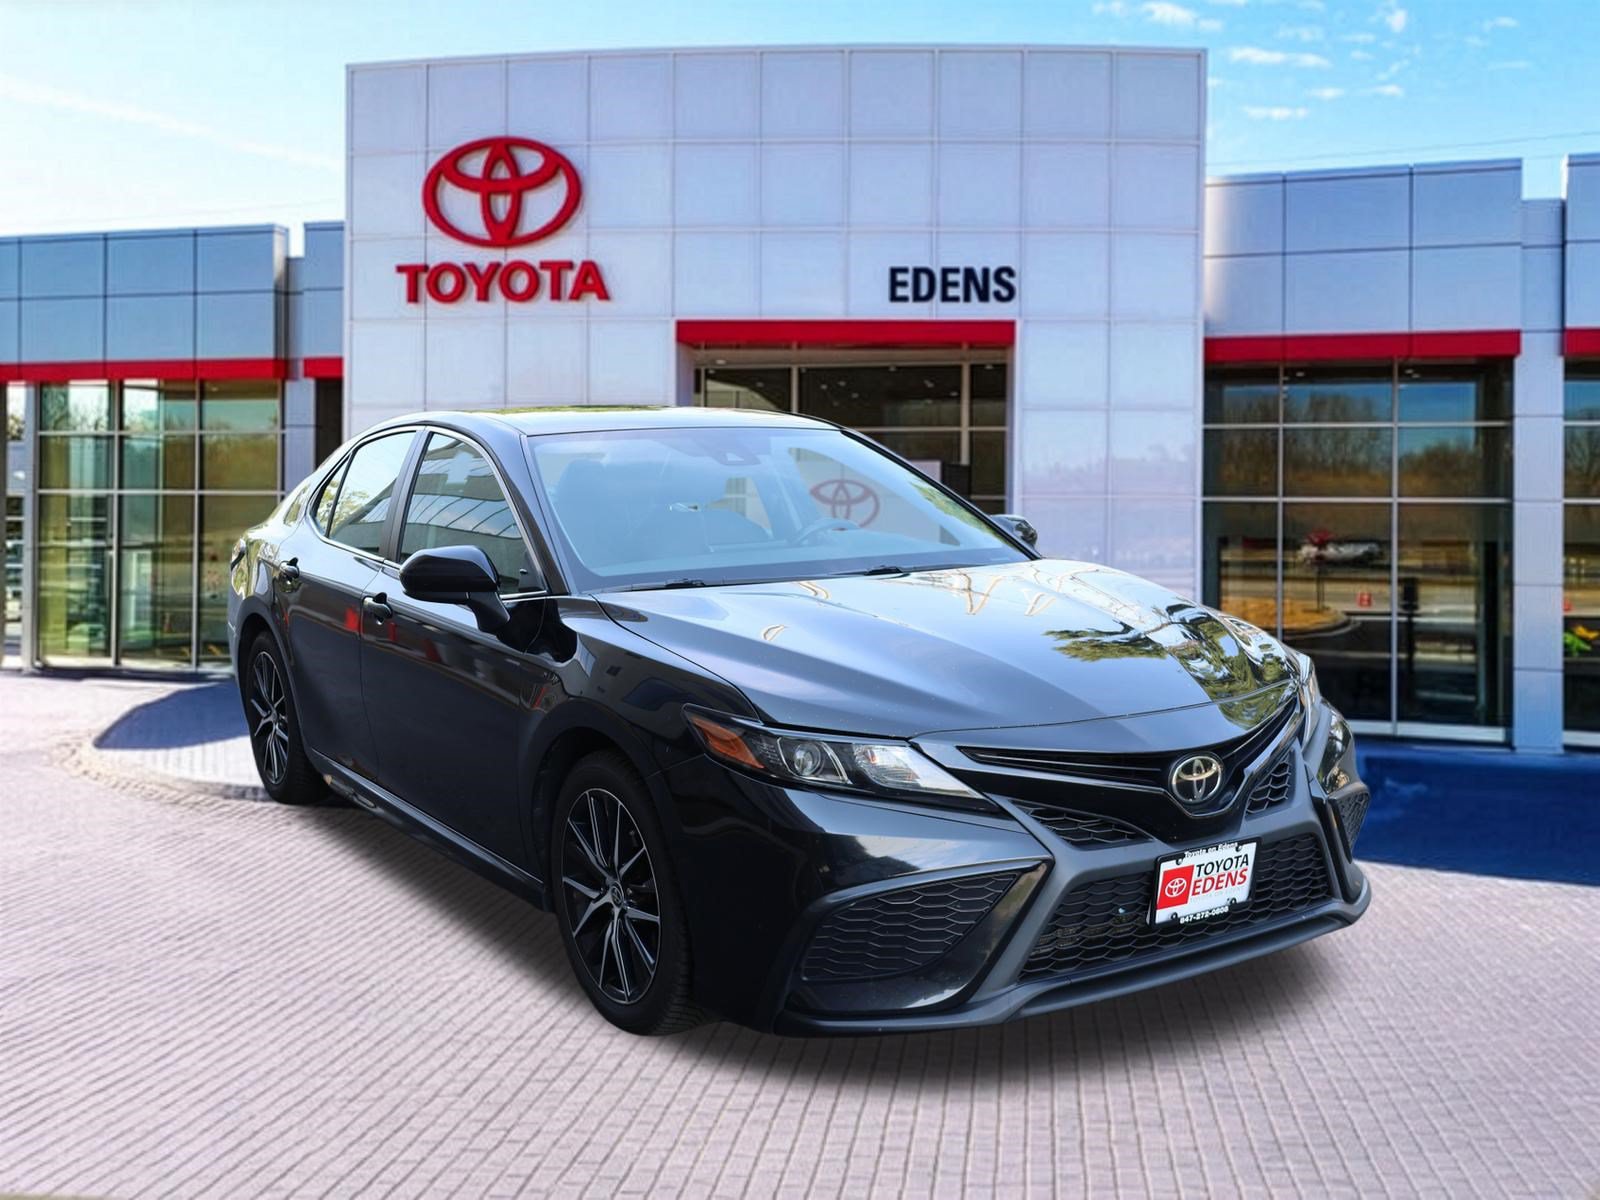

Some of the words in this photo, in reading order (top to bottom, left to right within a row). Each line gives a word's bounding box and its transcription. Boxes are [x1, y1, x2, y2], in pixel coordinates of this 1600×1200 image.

[396, 259, 611, 304] TOYOTA
[889, 266, 1017, 303] EDENS
[1191, 867, 1248, 896] EDENS
[1196, 854, 1249, 877] TOYOTA
